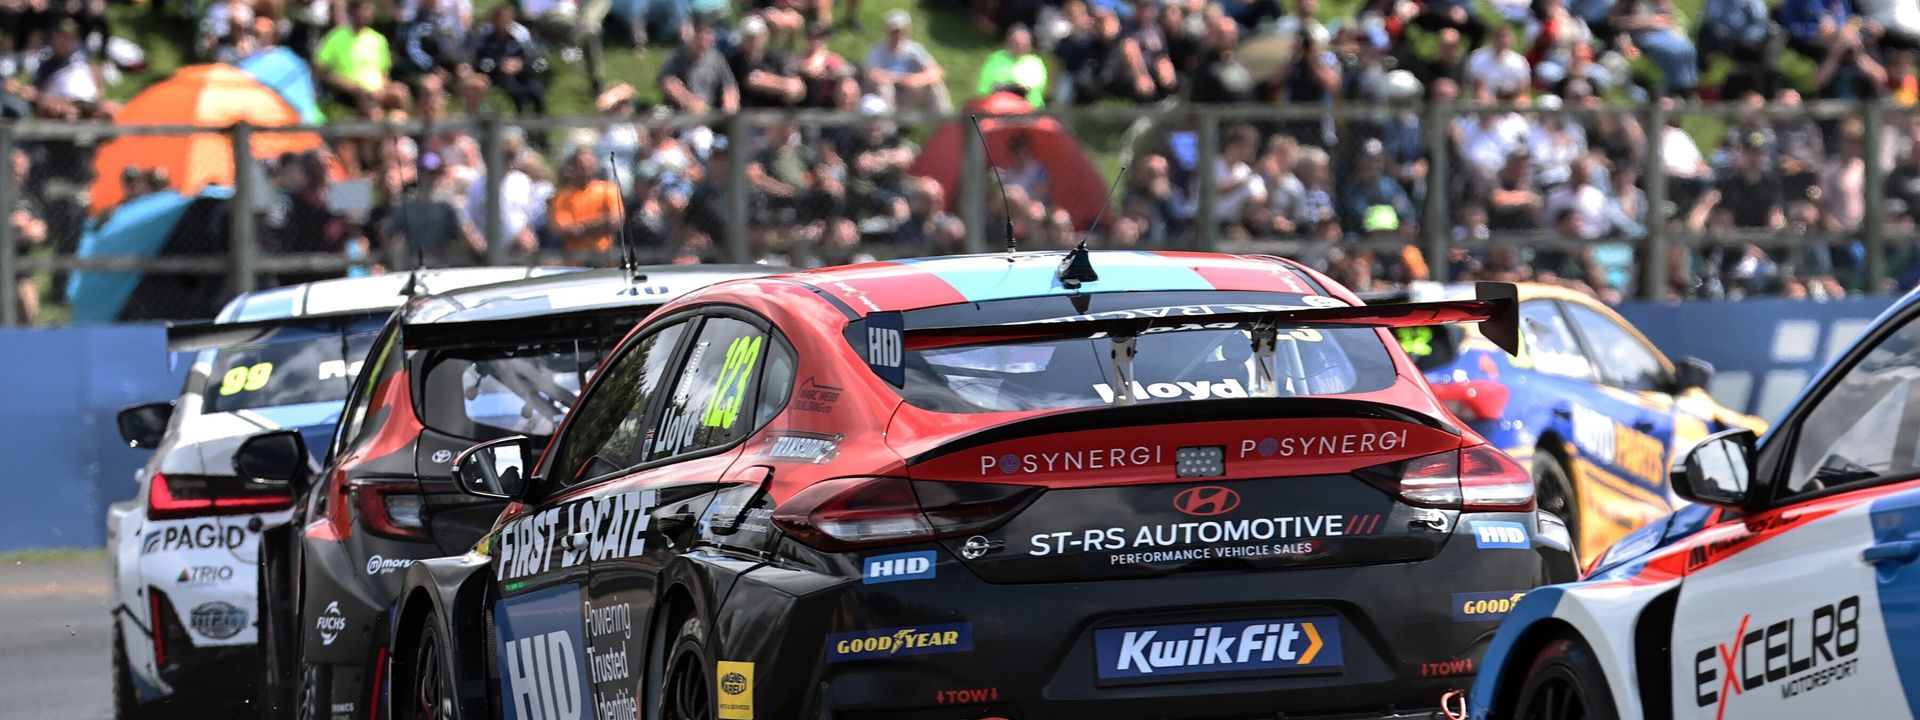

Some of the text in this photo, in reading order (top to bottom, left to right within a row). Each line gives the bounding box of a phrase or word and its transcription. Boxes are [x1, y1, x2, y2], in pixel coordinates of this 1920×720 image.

[868, 327, 902, 367] HID
[219, 362, 273, 396] 99
[703, 336, 762, 429] 123
[1092, 378, 1249, 403] Lloyd
[654, 404, 702, 457] Lloyd
[163, 525, 245, 550] PAGID
[496, 489, 657, 581] FIRST LOCATE
[1029, 514, 1344, 556] ST-RS AUTOMOTIVE
[1477, 526, 1526, 543] HID
[382, 559, 412, 568] mors
[870, 557, 930, 578] HID
[1111, 543, 1313, 565] PERFORMANCE VEHICLE SALES
[316, 616, 346, 630] FUCHS
[584, 596, 632, 640] Powering
[1463, 599, 1512, 615] GOOD
[587, 640, 630, 684] Trusted
[1429, 660, 1465, 676] TOW
[1695, 595, 1860, 718] EXCELR8
[506, 630, 581, 720] HID
[1781, 658, 1859, 700] MOTORSPORT
[594, 688, 637, 720] Identitie
[945, 689, 988, 703] TOW
